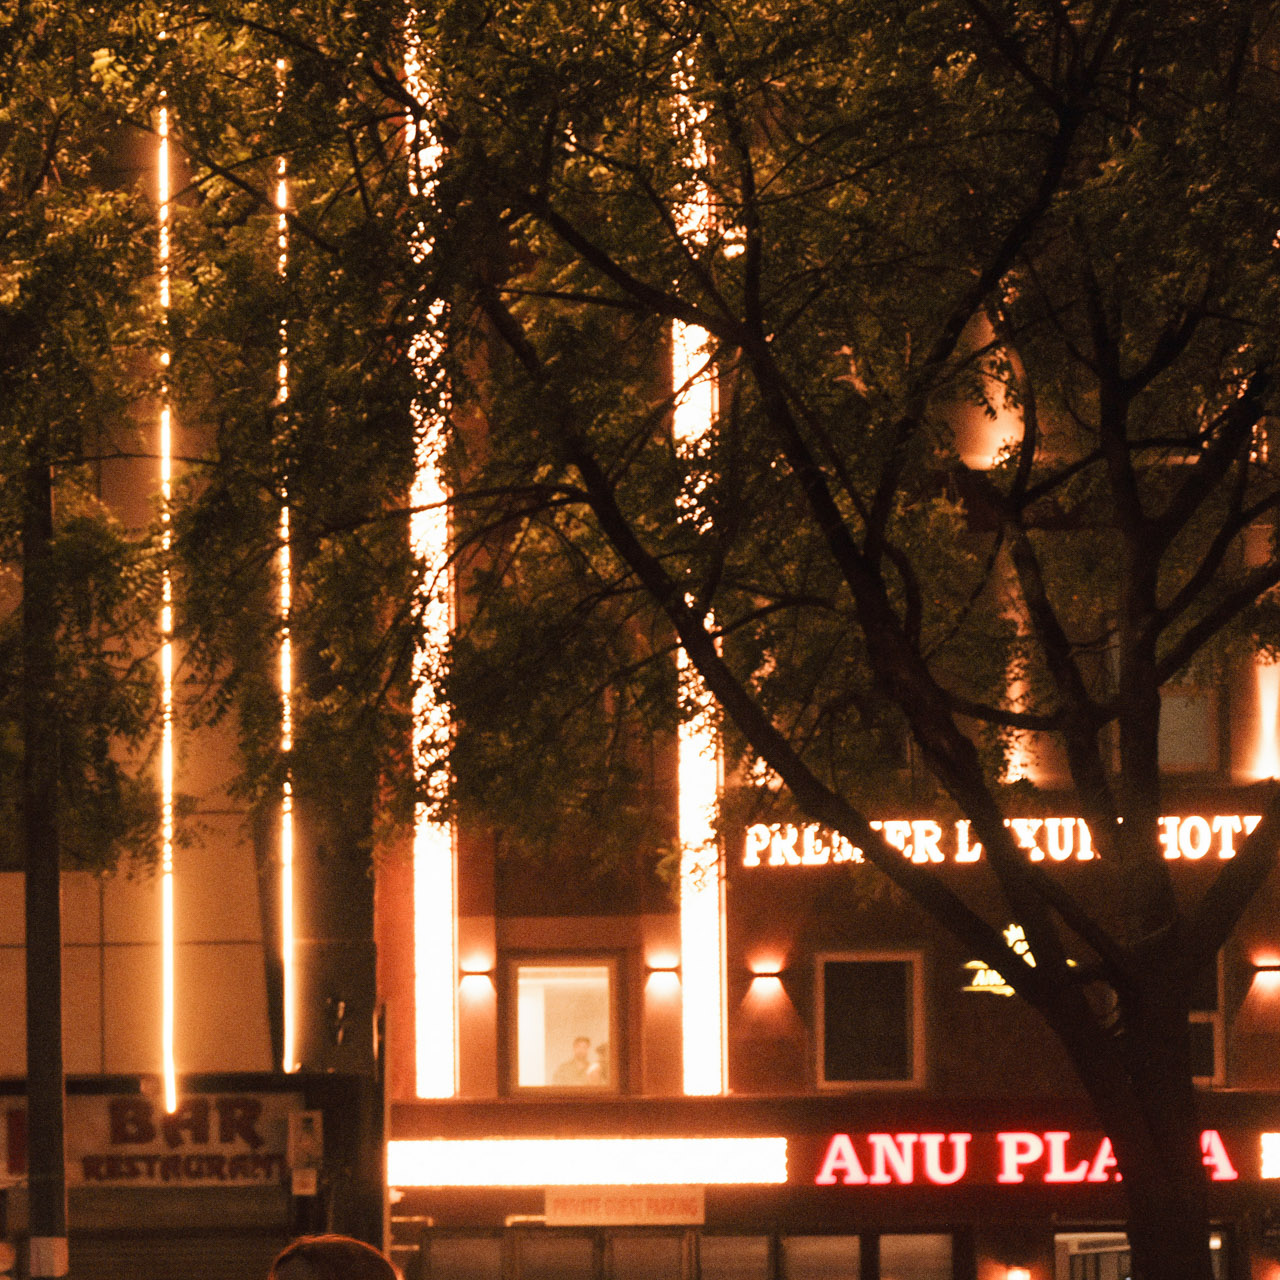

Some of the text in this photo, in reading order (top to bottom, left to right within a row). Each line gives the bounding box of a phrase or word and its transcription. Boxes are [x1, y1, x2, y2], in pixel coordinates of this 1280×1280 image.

[743, 820, 946, 867] PREER
[1158, 815, 1263, 860] HOT
[109, 1096, 265, 1149] BAR
[815, 1130, 1238, 1185] ANU PLAA
